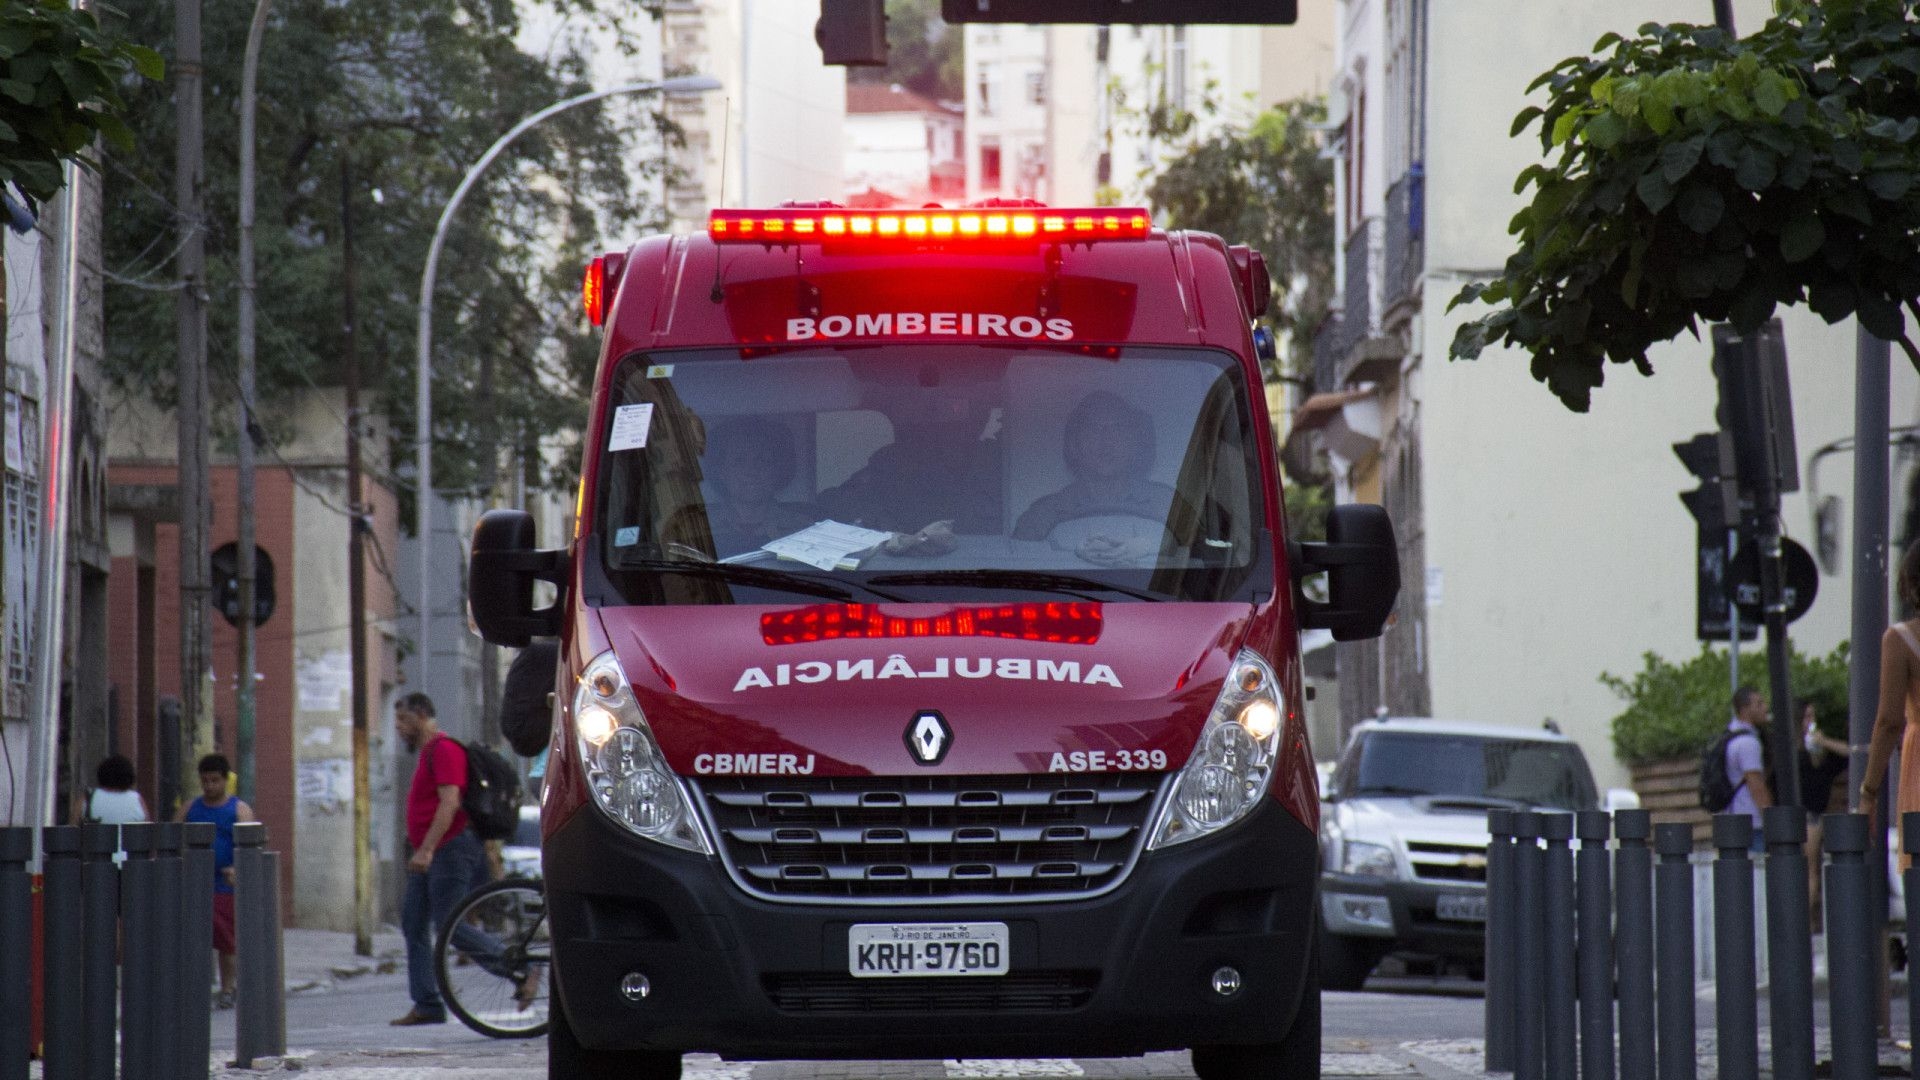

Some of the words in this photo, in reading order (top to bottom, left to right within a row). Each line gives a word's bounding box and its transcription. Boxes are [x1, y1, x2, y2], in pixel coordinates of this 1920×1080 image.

[786, 312, 1074, 341] BOMBEIROS
[694, 753, 815, 775] CBMERJ
[1048, 749, 1168, 773] ASE-339
[937, 931, 970, 939] JANEIRO
